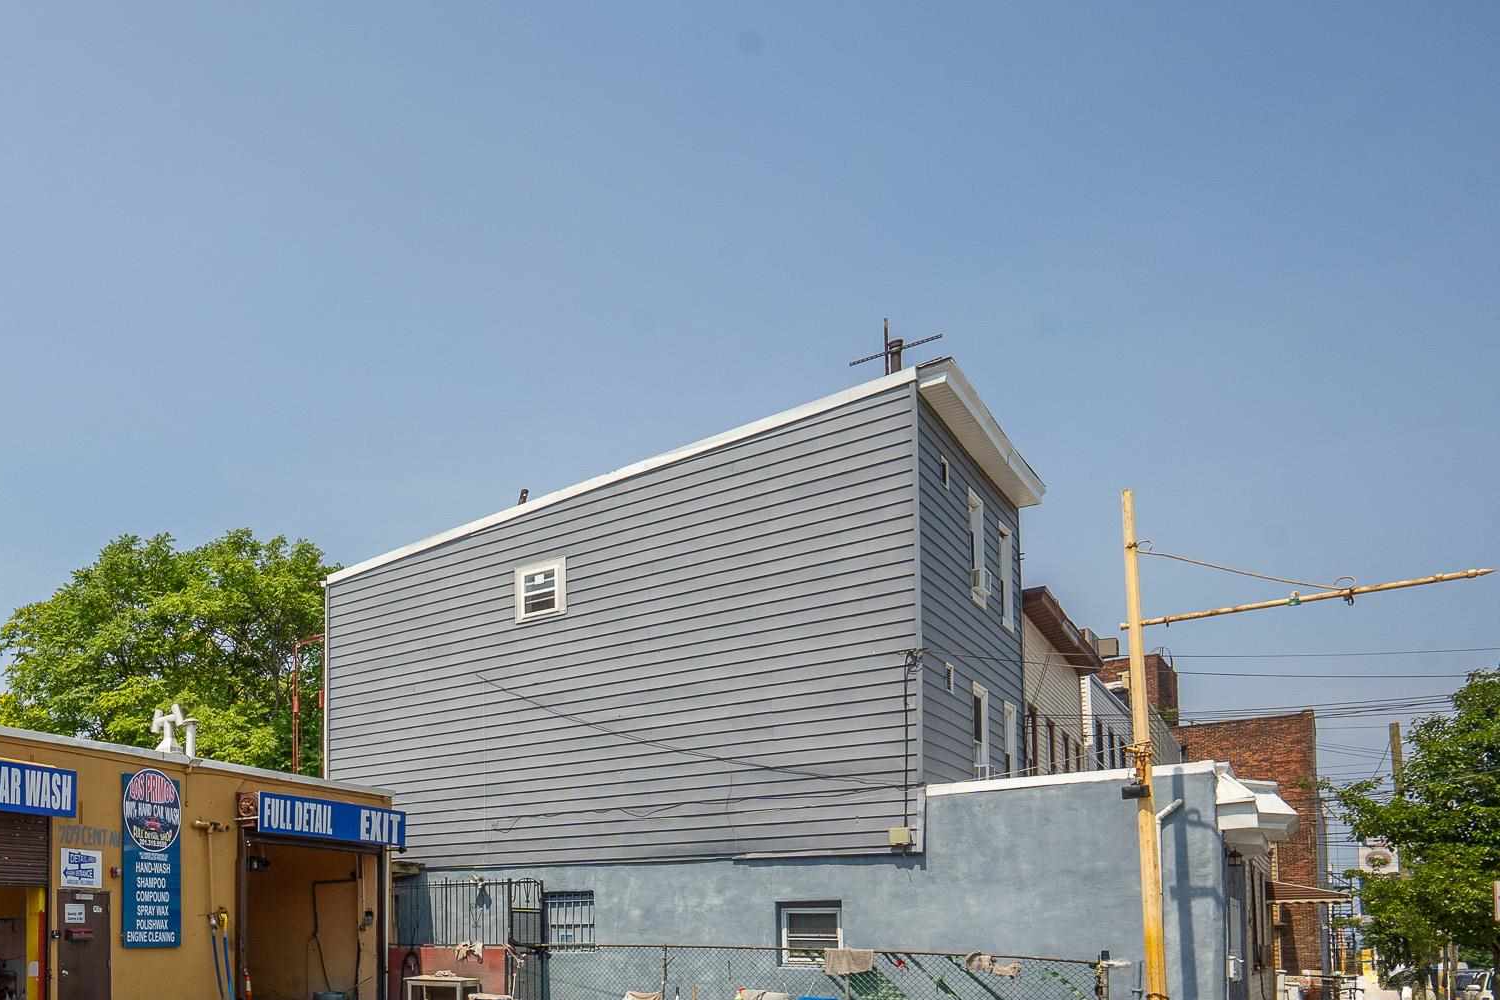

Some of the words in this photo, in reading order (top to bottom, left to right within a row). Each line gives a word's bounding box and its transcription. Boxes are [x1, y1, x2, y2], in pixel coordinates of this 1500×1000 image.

[25, 769, 72, 811] WASH
[130, 773, 145, 801] LOS
[145, 773, 175, 803] PRIMOS
[138, 802, 152, 817] HAND
[152, 804, 164, 818] CAR
[164, 806, 180, 825] WASH
[263, 797, 292, 830] FULL
[295, 801, 333, 835] DETAIL
[360, 809, 401, 844] EXIT
[135, 861, 171, 874] HAND-WASH
[136, 876, 166, 888] SHAMPOO
[135, 890, 170, 902] COMPOUND
[136, 904, 156, 916] SPRAY
[156, 905, 169, 916] WAX
[126, 931, 148, 942] ENGINE
[147, 931, 175, 942] CLEANING
